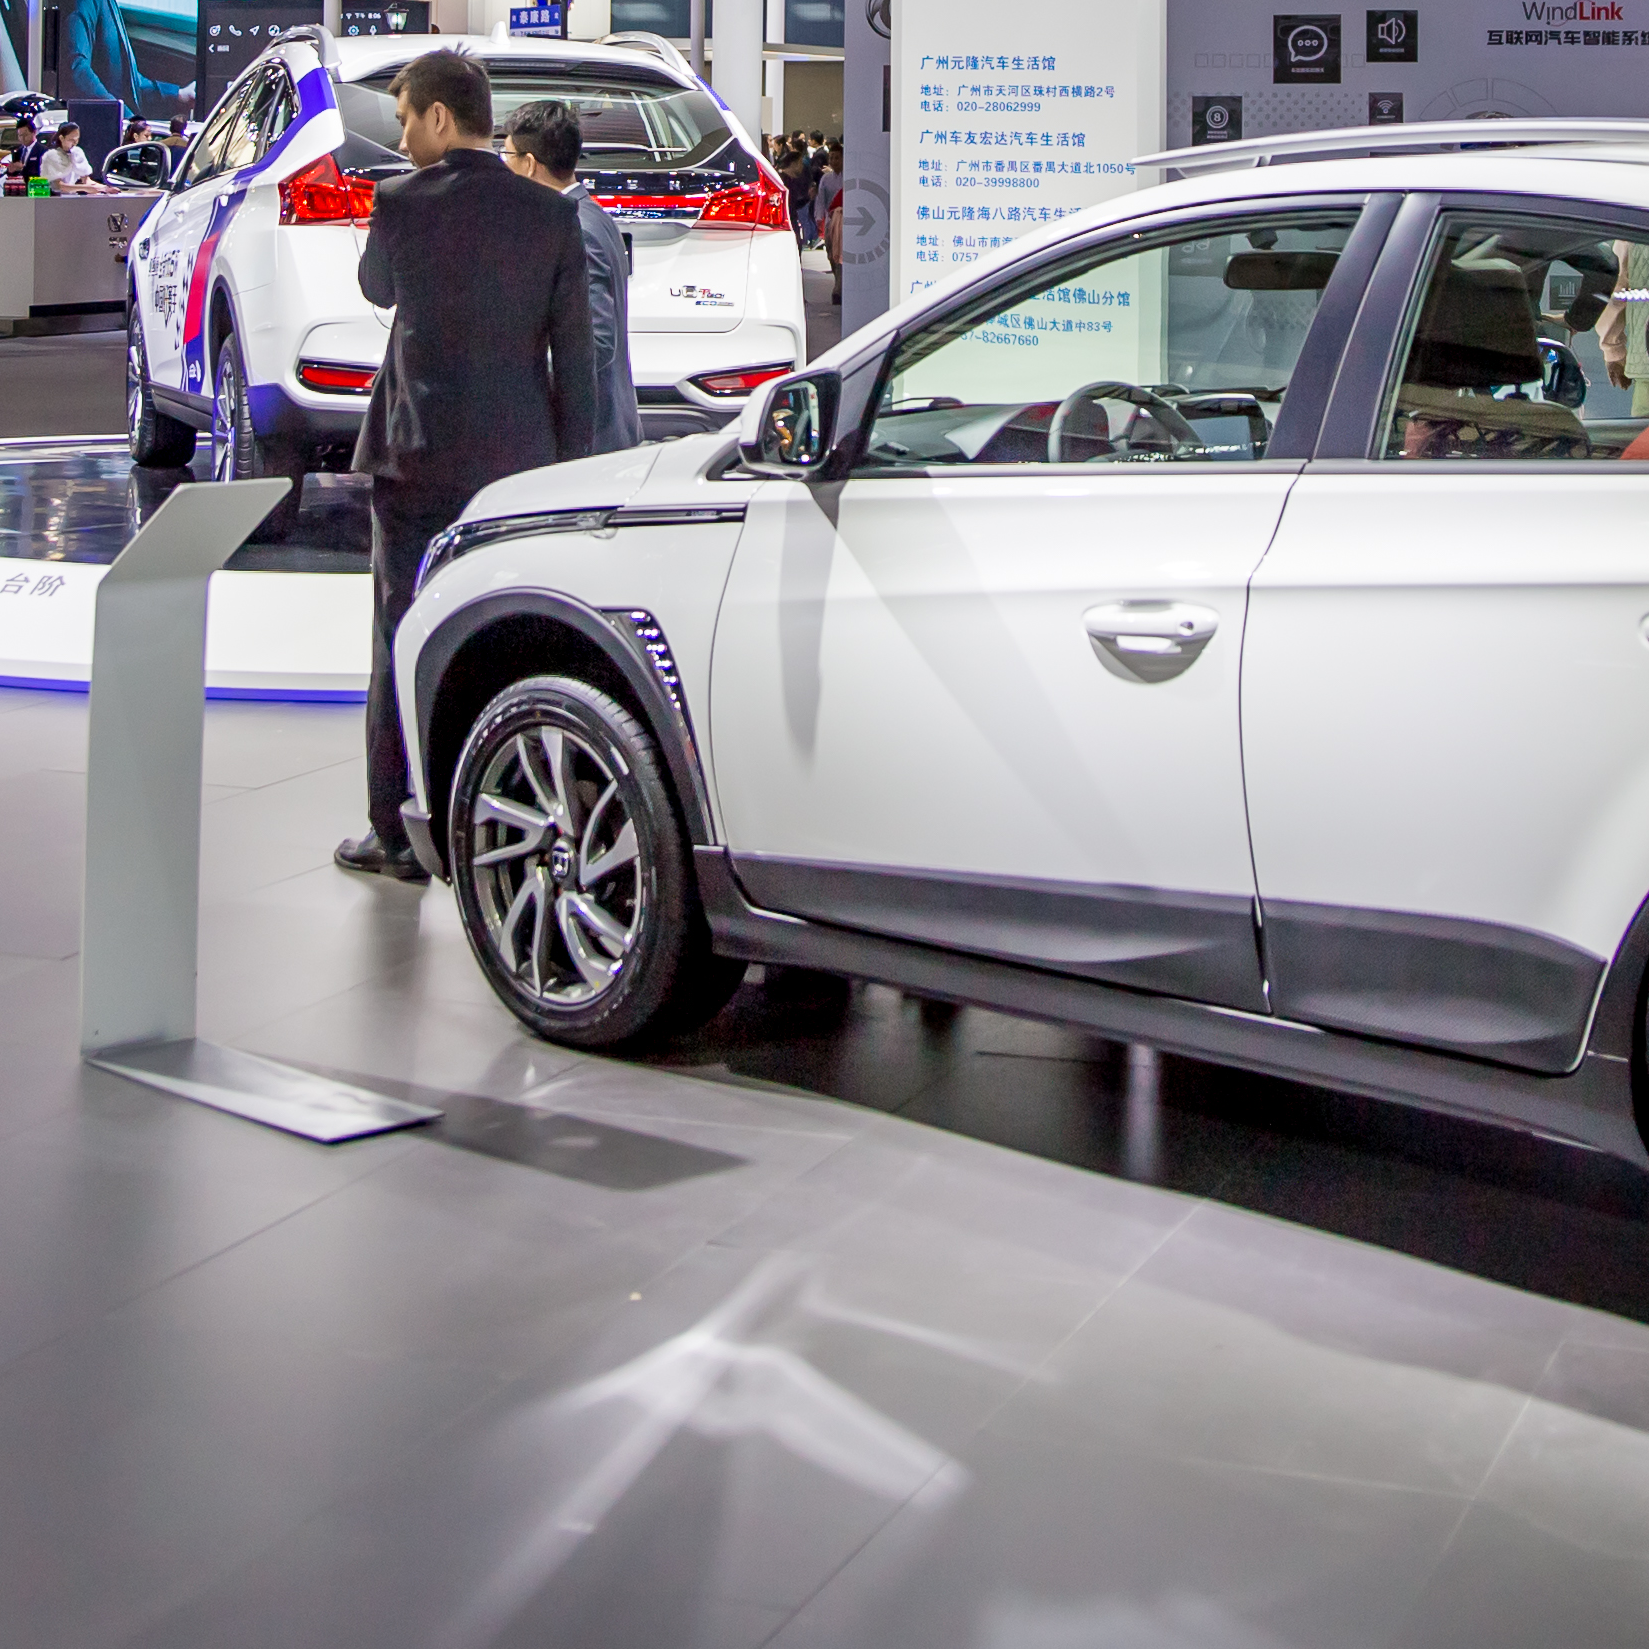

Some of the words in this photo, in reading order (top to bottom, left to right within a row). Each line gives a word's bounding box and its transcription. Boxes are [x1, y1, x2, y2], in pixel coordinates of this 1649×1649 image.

[920, 55, 1057, 72] 广州元隆汽车生活馆
[919, 129, 1086, 148] 广州车友宏达汽车生活馆
